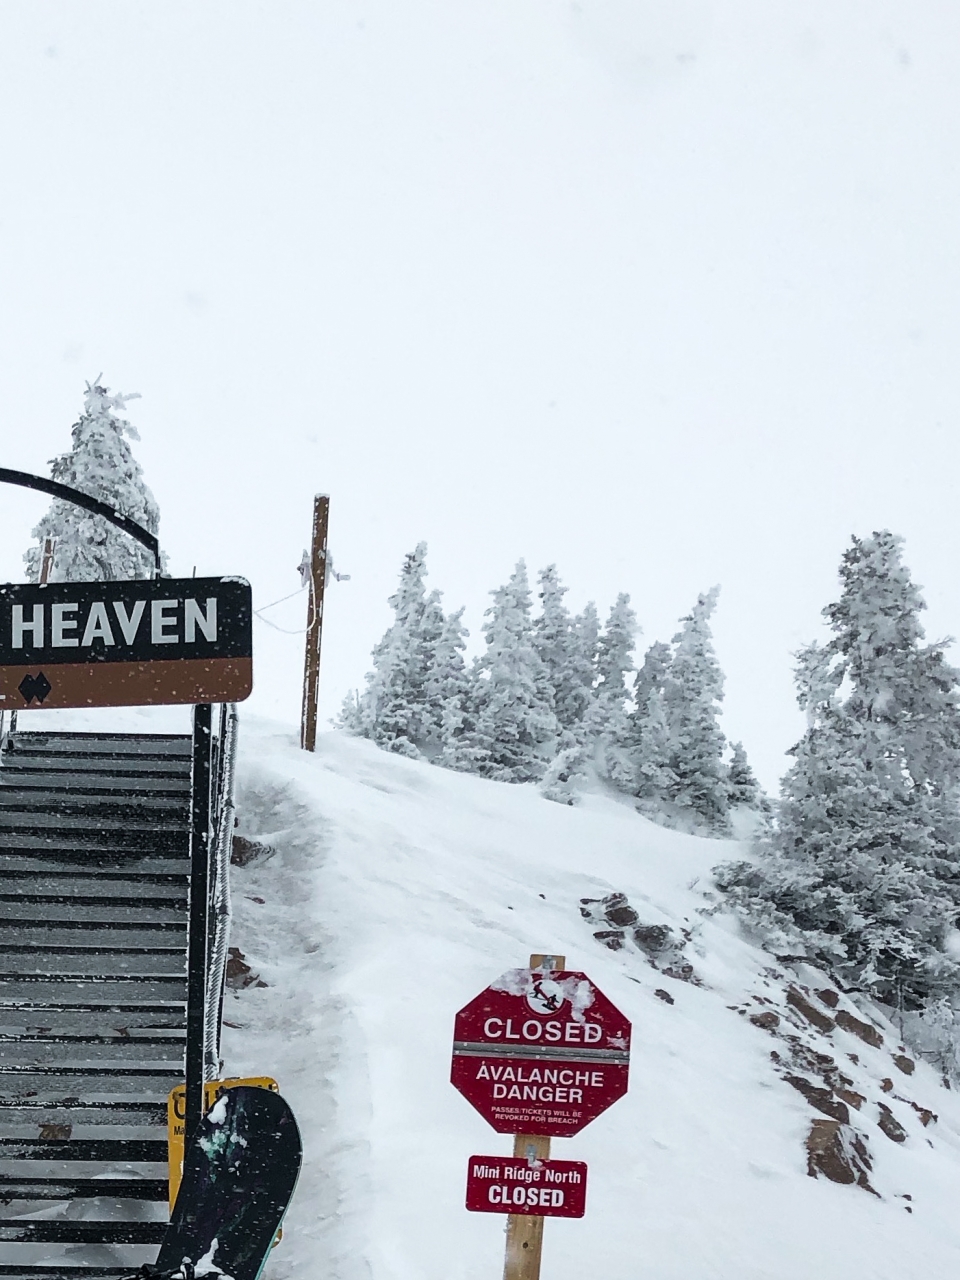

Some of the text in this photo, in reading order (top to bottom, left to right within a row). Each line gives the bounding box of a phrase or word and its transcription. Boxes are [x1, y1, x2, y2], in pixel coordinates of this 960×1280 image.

[11, 597, 218, 650] HEAVEN
[484, 1017, 602, 1043] CLOSED
[476, 1065, 604, 1087] AVALANCHE
[493, 1084, 583, 1103] DANGER
[495, 1113, 578, 1125] REVOKED FOR BREACH
[473, 1165, 581, 1184] Mini Ridge North
[488, 1185, 564, 1207] CLOSED
